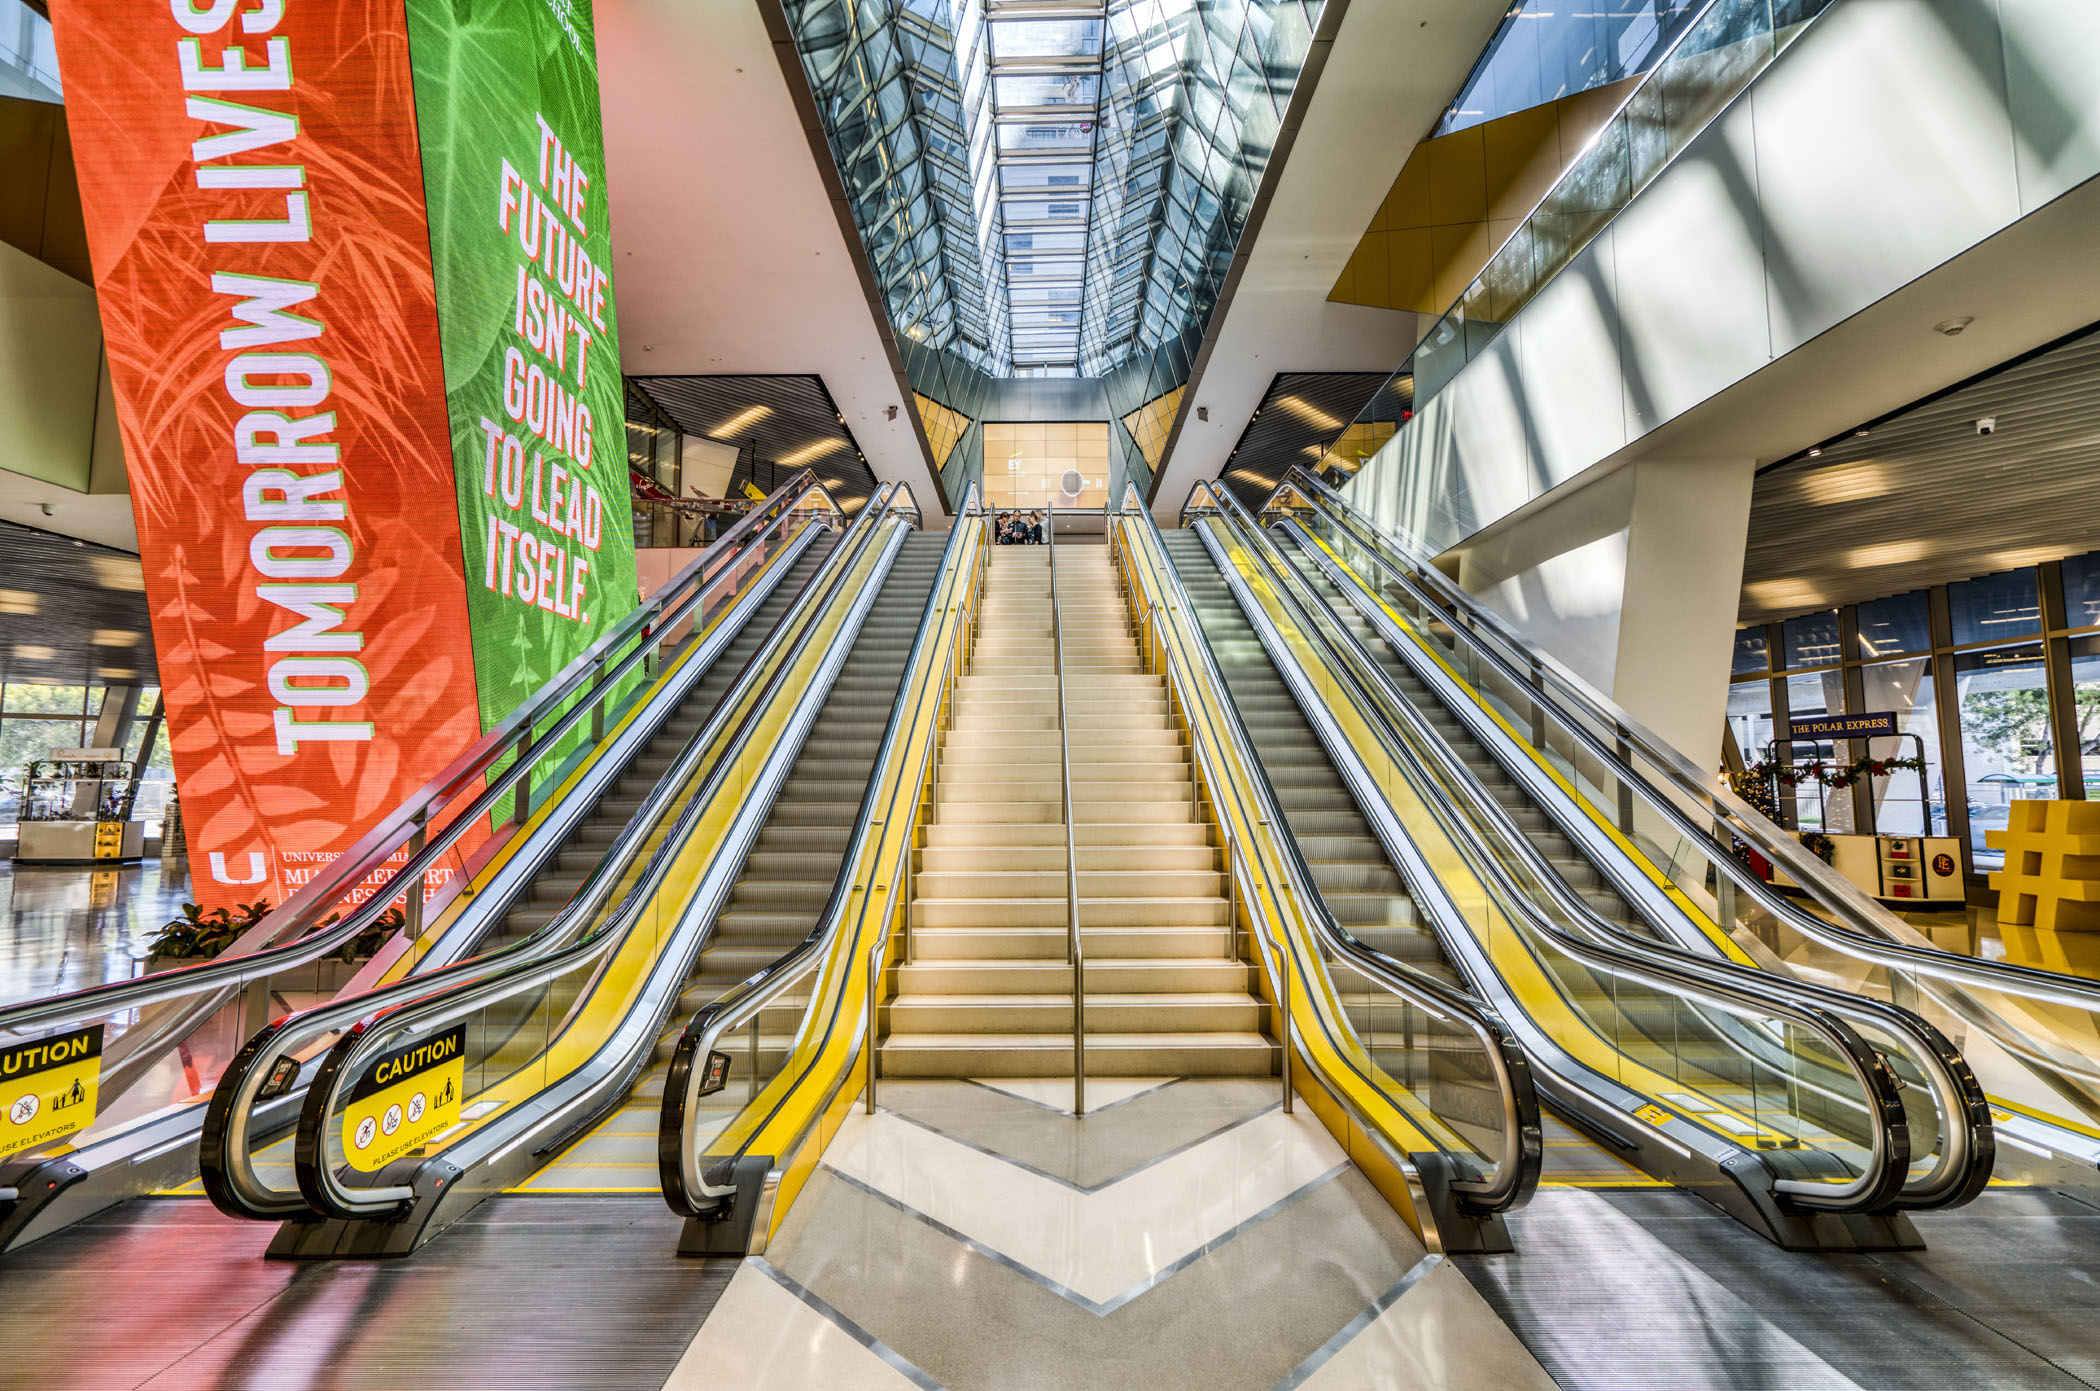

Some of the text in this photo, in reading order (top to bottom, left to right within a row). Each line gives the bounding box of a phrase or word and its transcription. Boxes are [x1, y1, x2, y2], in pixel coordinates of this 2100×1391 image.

[170, 0, 313, 243] LIVES
[536, 112, 589, 239] THE
[499, 157, 608, 336] FUTURE
[515, 264, 592, 391] ISN'T
[504, 346, 593, 470] GOING
[1007, 460, 1021, 470] EY
[210, 270, 375, 756] TOMORROW
[480, 415, 602, 552] TO LEAD
[486, 514, 589, 625] ITSELF.
[1792, 725, 1810, 734] THE
[1813, 722, 1844, 733] POLAR
[375, 1034, 456, 1084] CAUTION
[20, 1122, 76, 1146] ELEVATORS
[373, 1121, 449, 1166] PLEASE USE ELEVATORS
